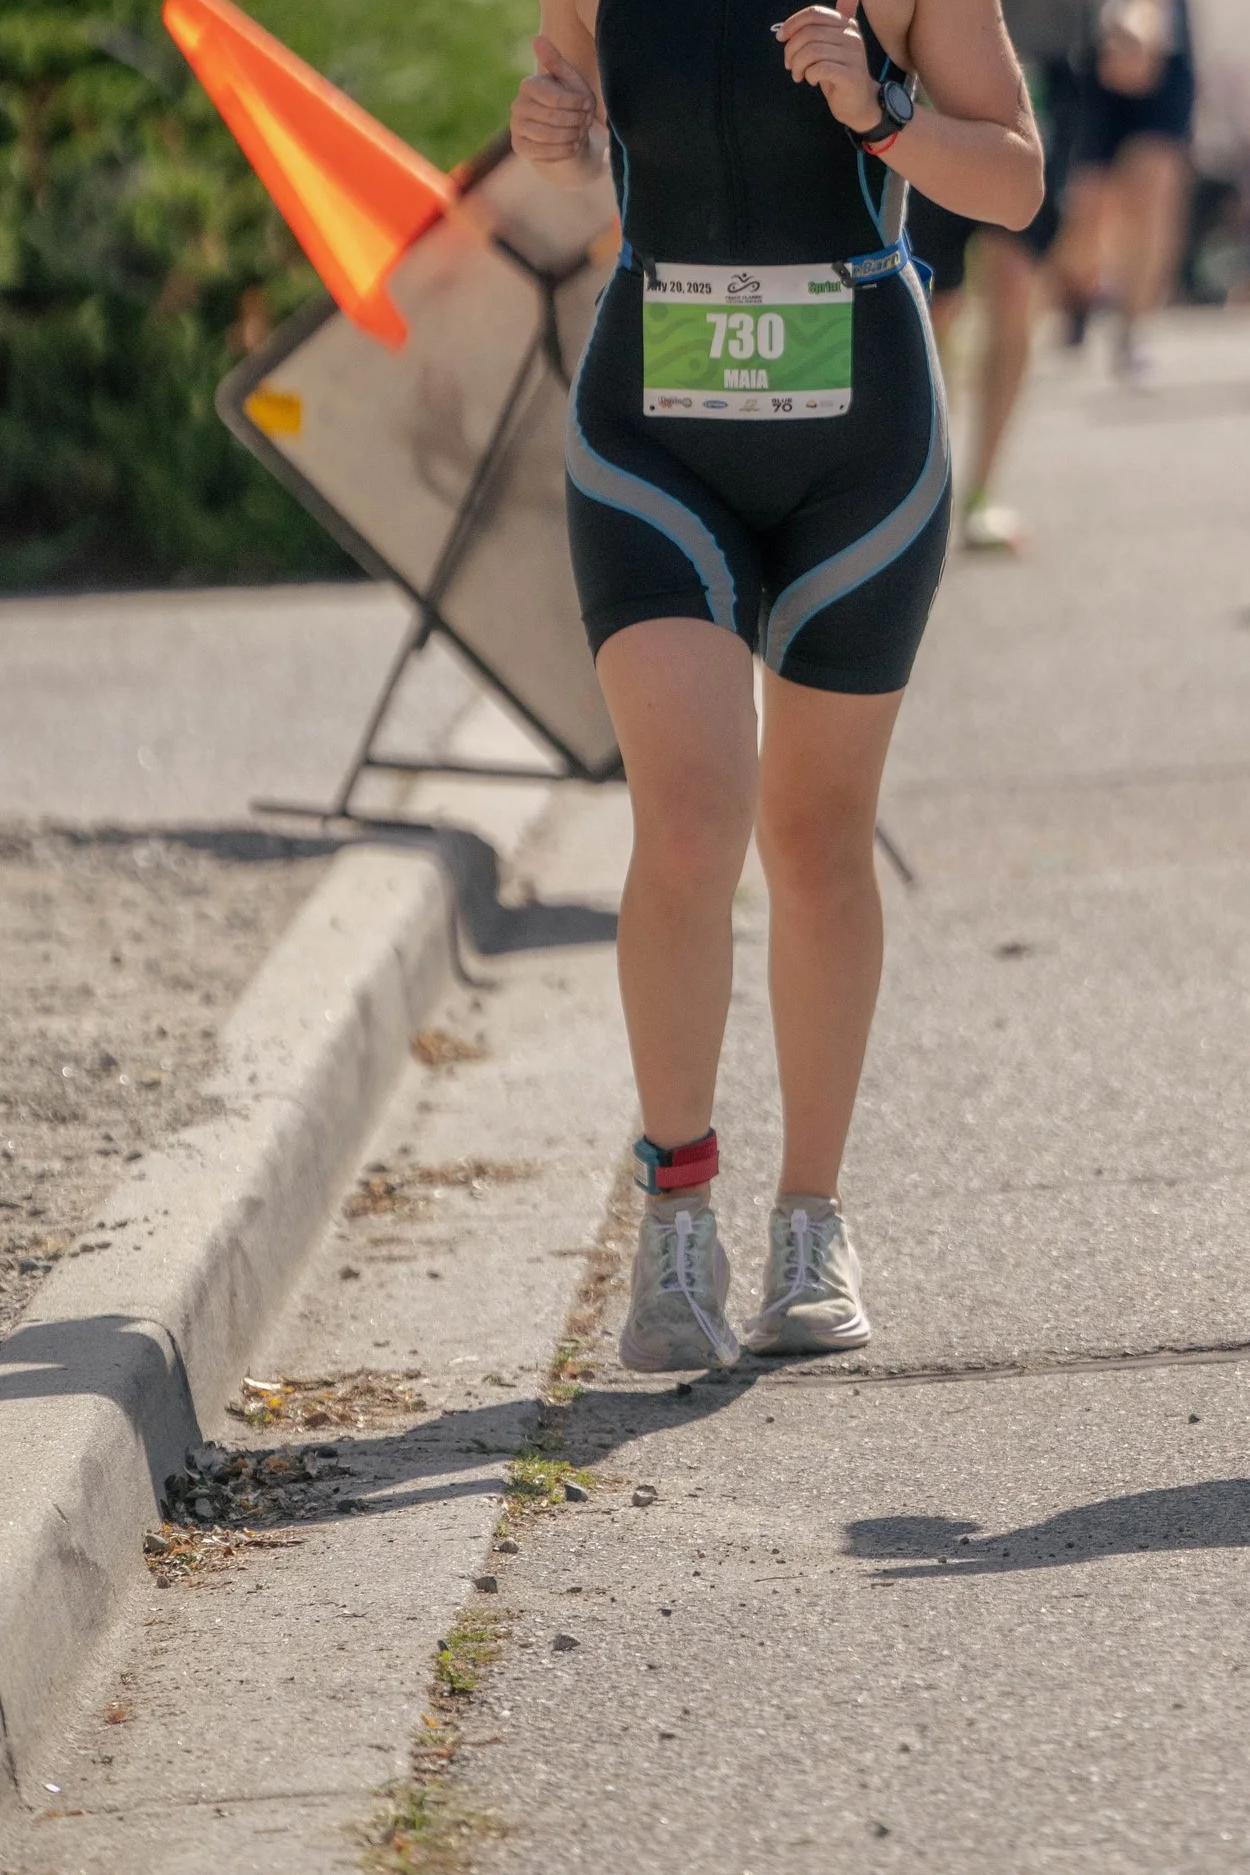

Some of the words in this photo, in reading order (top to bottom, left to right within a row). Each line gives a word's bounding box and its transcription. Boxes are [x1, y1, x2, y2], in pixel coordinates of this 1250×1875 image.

[687, 281, 711, 294] 2025
[808, 281, 841, 294] Sprint
[706, 312, 784, 359] 730
[724, 369, 769, 389] MAIA
[772, 403, 792, 413] 70
